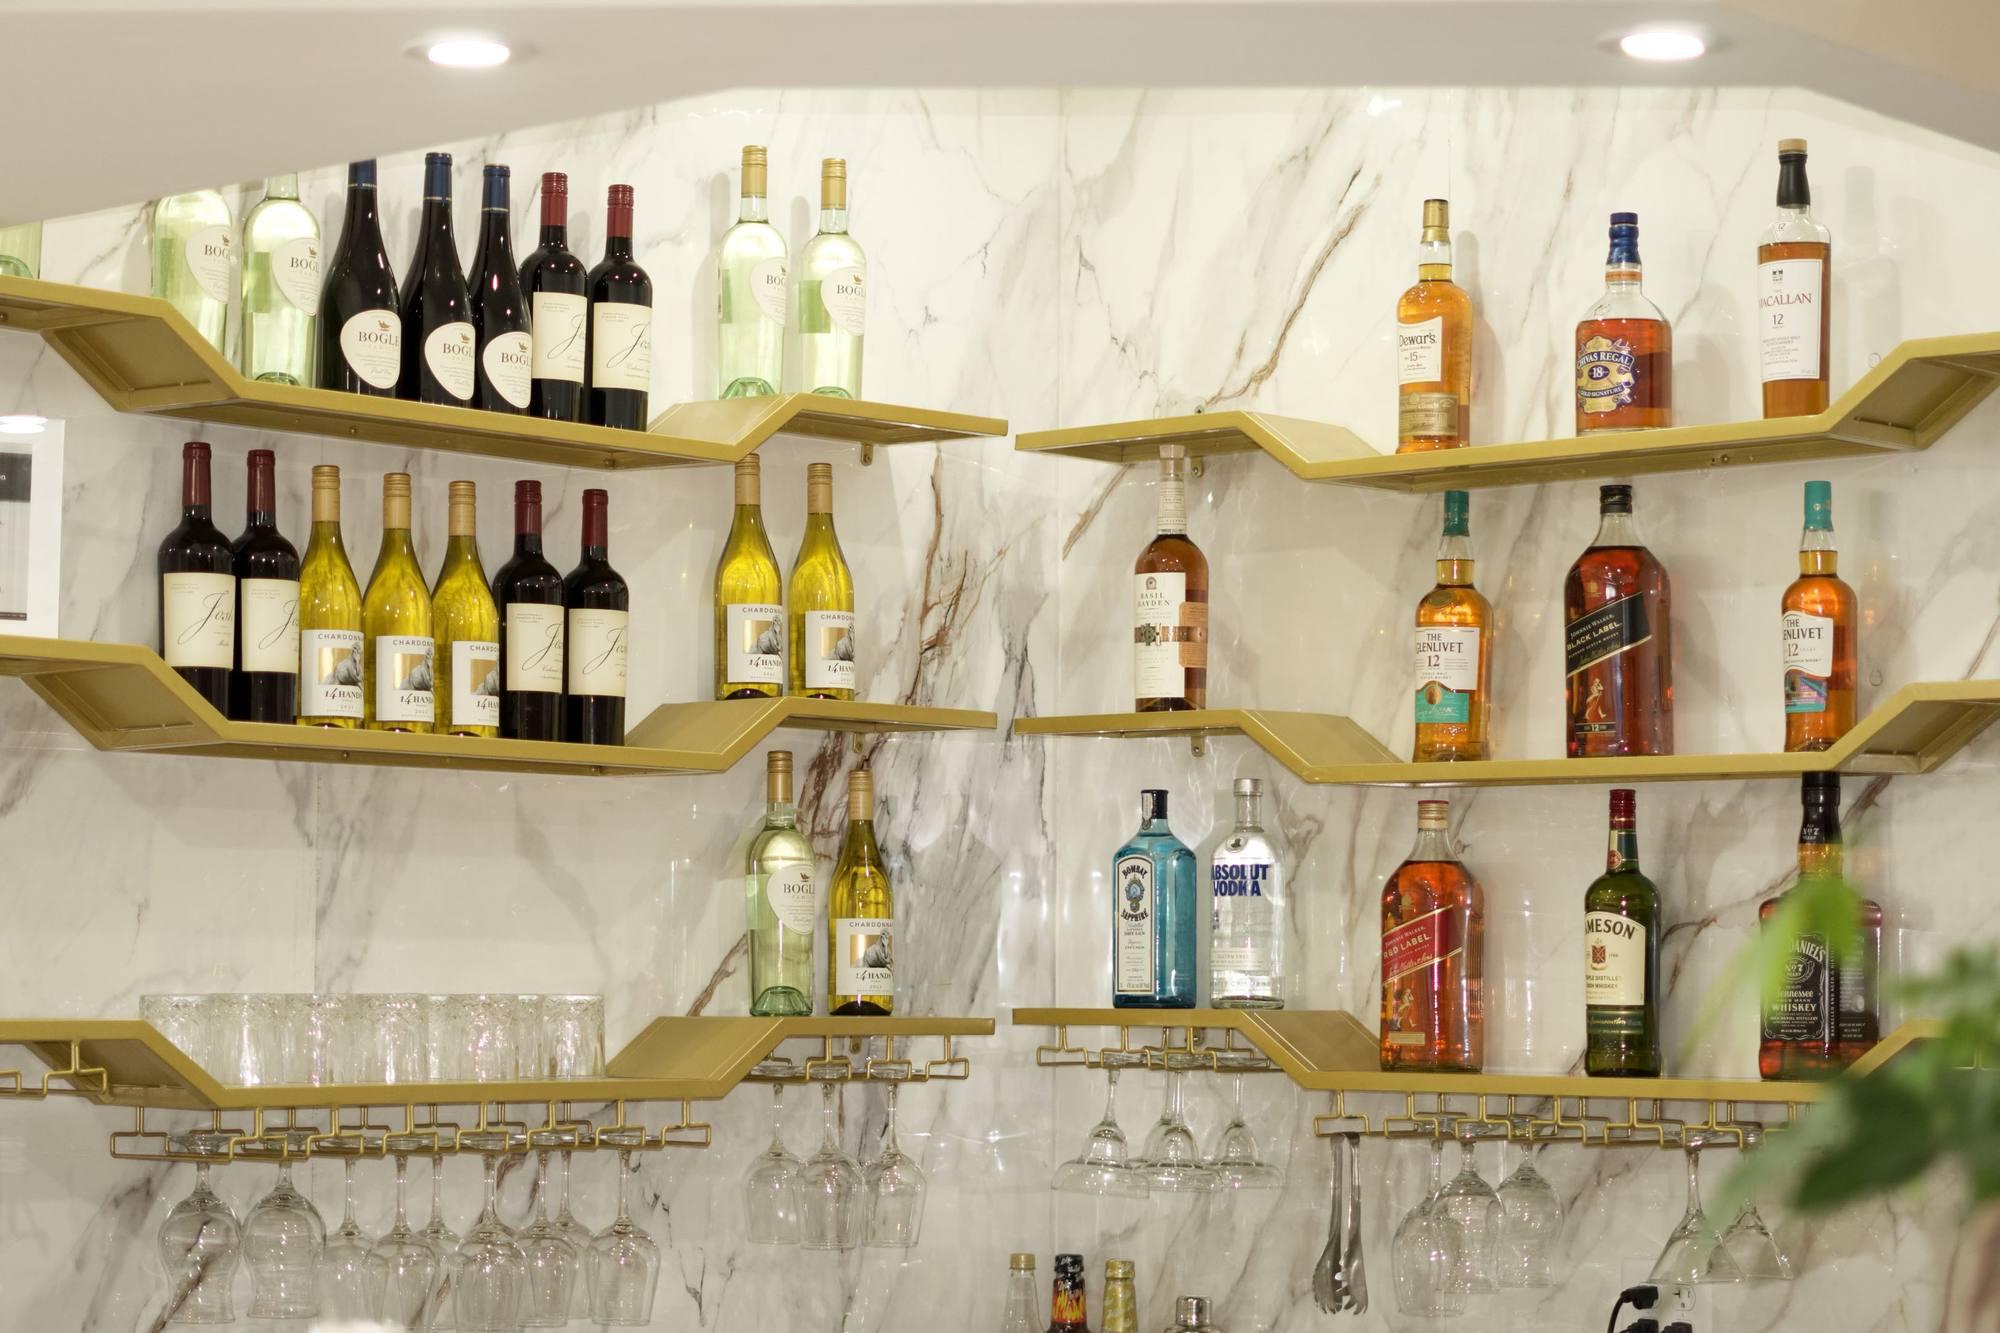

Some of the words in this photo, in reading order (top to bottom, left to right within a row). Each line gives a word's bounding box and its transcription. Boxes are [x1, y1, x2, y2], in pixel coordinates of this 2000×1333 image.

[1772, 314, 1784, 325] 12
[1409, 352, 1418, 362] 15
[1599, 351, 1630, 365] REGAL
[1592, 366, 1603, 378] 18
[1787, 618, 1799, 628] THE
[1427, 633, 1442, 641] THE
[1567, 633, 1592, 651] BLACK
[1592, 621, 1620, 638] LABEL
[1788, 643, 1799, 657] 12
[1427, 655, 1441, 667] 12
[1121, 864, 1148, 879] BOMBAY
[1211, 863, 1269, 880] ABSOLUT
[1213, 880, 1262, 896] VODKA
[1120, 908, 1149, 922] SAPPHIRE
[1383, 946, 1399, 960] RED
[1400, 933, 1430, 951] LABEL
[1771, 1003, 1817, 1012] WHISKEY
